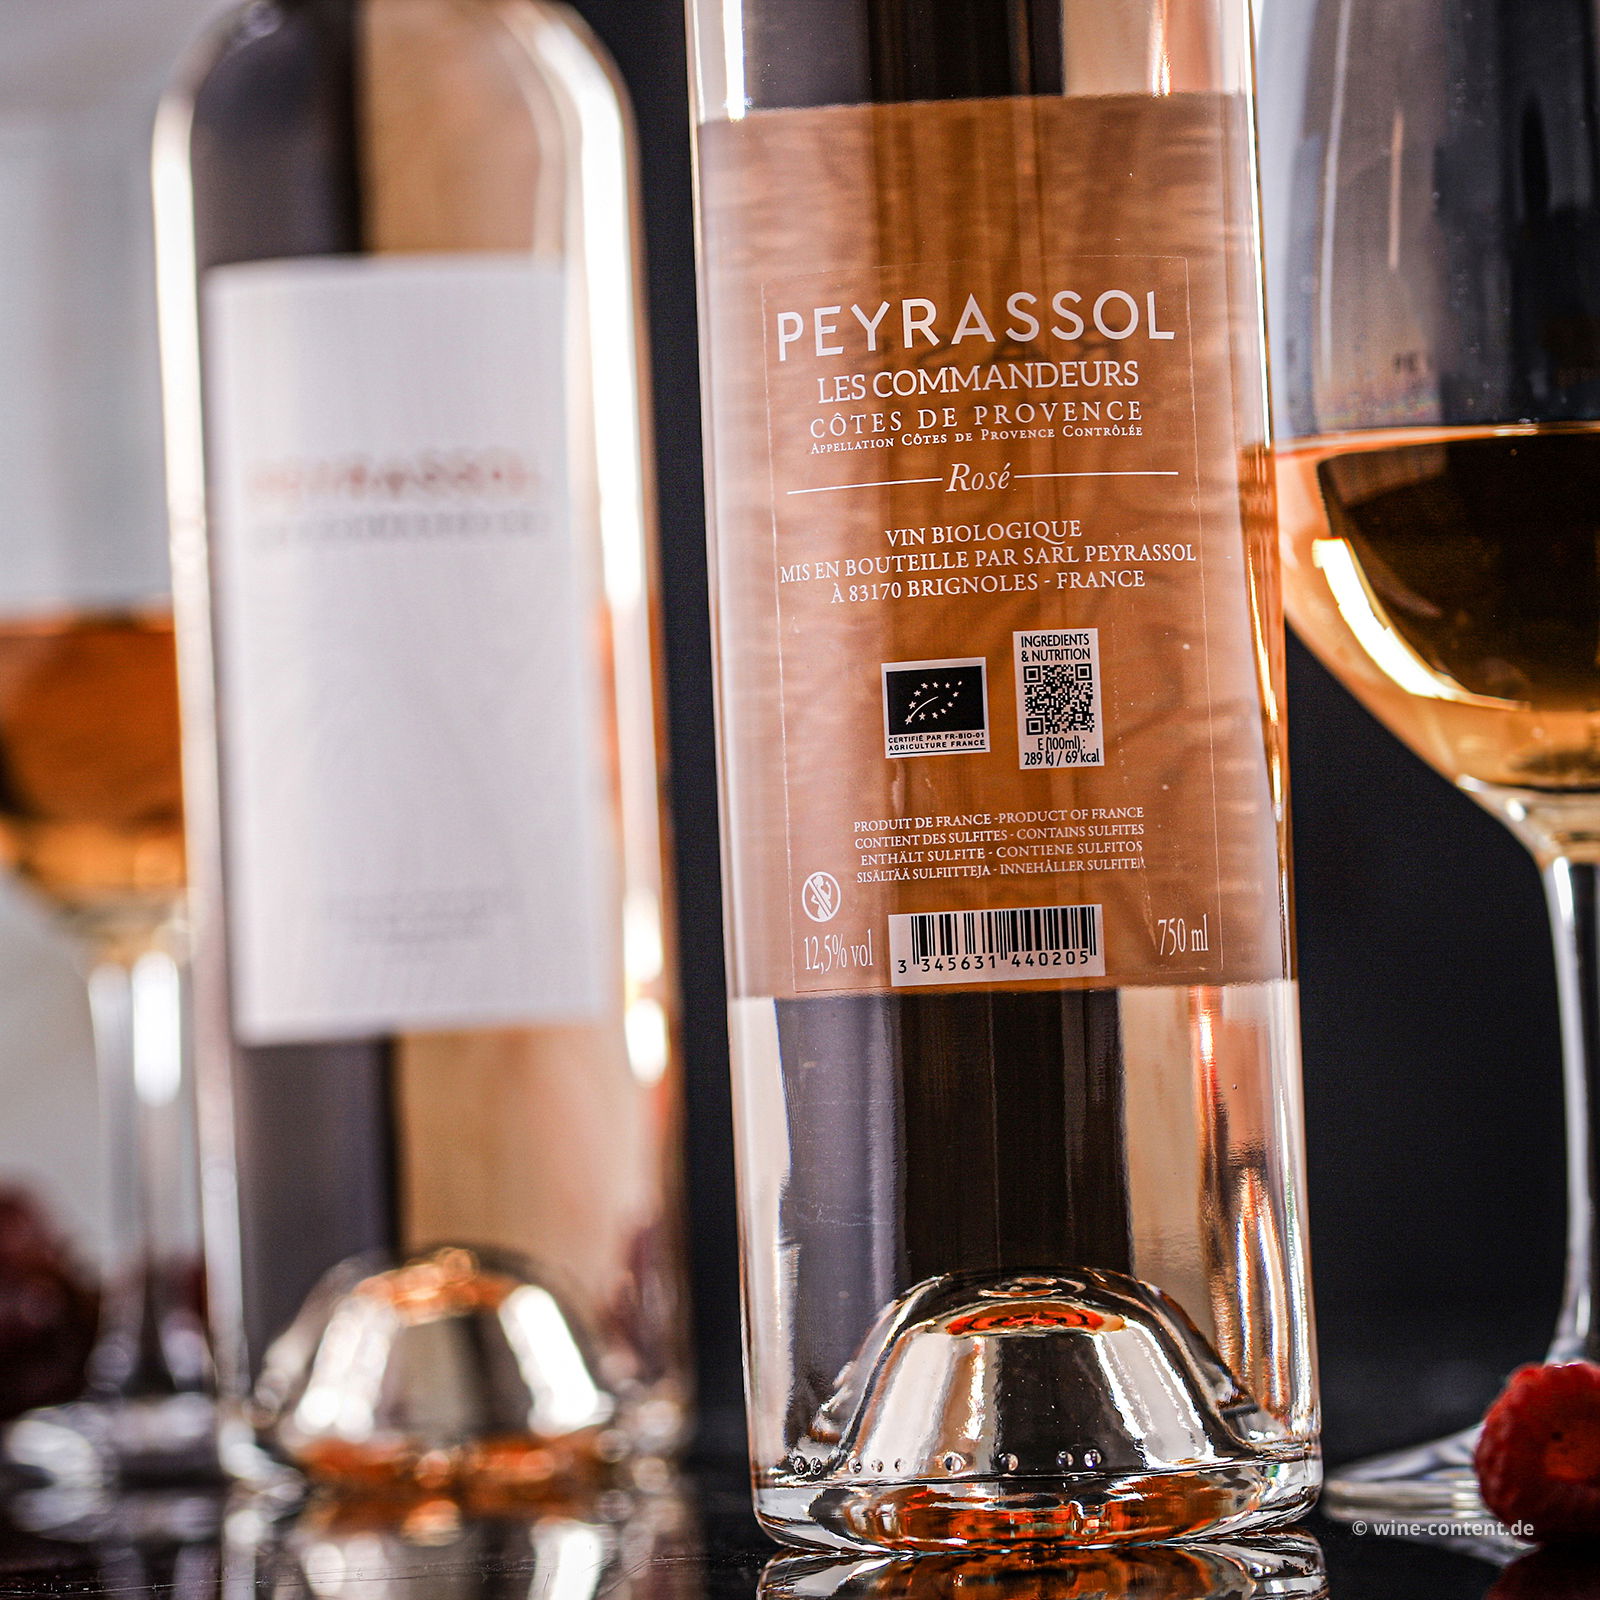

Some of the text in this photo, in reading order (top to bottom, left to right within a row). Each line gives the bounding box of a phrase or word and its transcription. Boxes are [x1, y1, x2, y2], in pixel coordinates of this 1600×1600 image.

[777, 290, 1175, 361] PEYRASSOL
[817, 360, 1139, 403] LES COMMANDEURS
[810, 401, 1142, 438] CÔTES DE PROVENCE
[944, 462, 1011, 492] Rosé
[885, 520, 1082, 547] VIN BIOLOGIQUE
[780, 543, 1196, 583] MIS EN BOUTEILLE PAR SARL PEYRASSOL
[831, 583, 844, 603] À
[849, 582, 901, 602] 83170
[907, 573, 1038, 597] BRIGNOLES
[1056, 570, 1145, 589] FRANCE
[1021, 634, 1089, 648] INGREDIENTS
[1021, 648, 1090, 662] & NUTRITION
[888, 735, 923, 743] CERTIFIÉ
[889, 742, 946, 751] AGRICULTURE
[1038, 738, 1044, 750] E
[1024, 752, 1042, 765] 289
[1065, 750, 1078, 763] 69
[1080, 748, 1100, 763] kcal
[854, 818, 912, 832] PRODUIT
[915, 817, 933, 829] DE
[936, 814, 991, 827] FRANCE
[1070, 809, 1089, 820] OF
[1092, 807, 1144, 819] FRANCE
[855, 835, 920, 849] CONTIENT
[923, 833, 946, 845] DES
[949, 830, 1007, 844] SULFITES
[1017, 826, 1085, 840] CONTAINS
[1088, 824, 1144, 837] SULFITES
[861, 850, 924, 866] ENTHÄLT
[928, 848, 985, 862] SULFITE
[996, 844, 1074, 858] CONTIENE
[1077, 841, 1143, 854] SULFITOS
[857, 867, 910, 883] SISÄLTÄÄ
[912, 864, 991, 880] SULFIITTEJA
[1000, 859, 1087, 875] INNEHÅLLER
[1158, 914, 1209, 956] 750 ml
[804, 929, 873, 974] 12,5% vol
[898, 951, 1089, 973] 3 345631 440205
